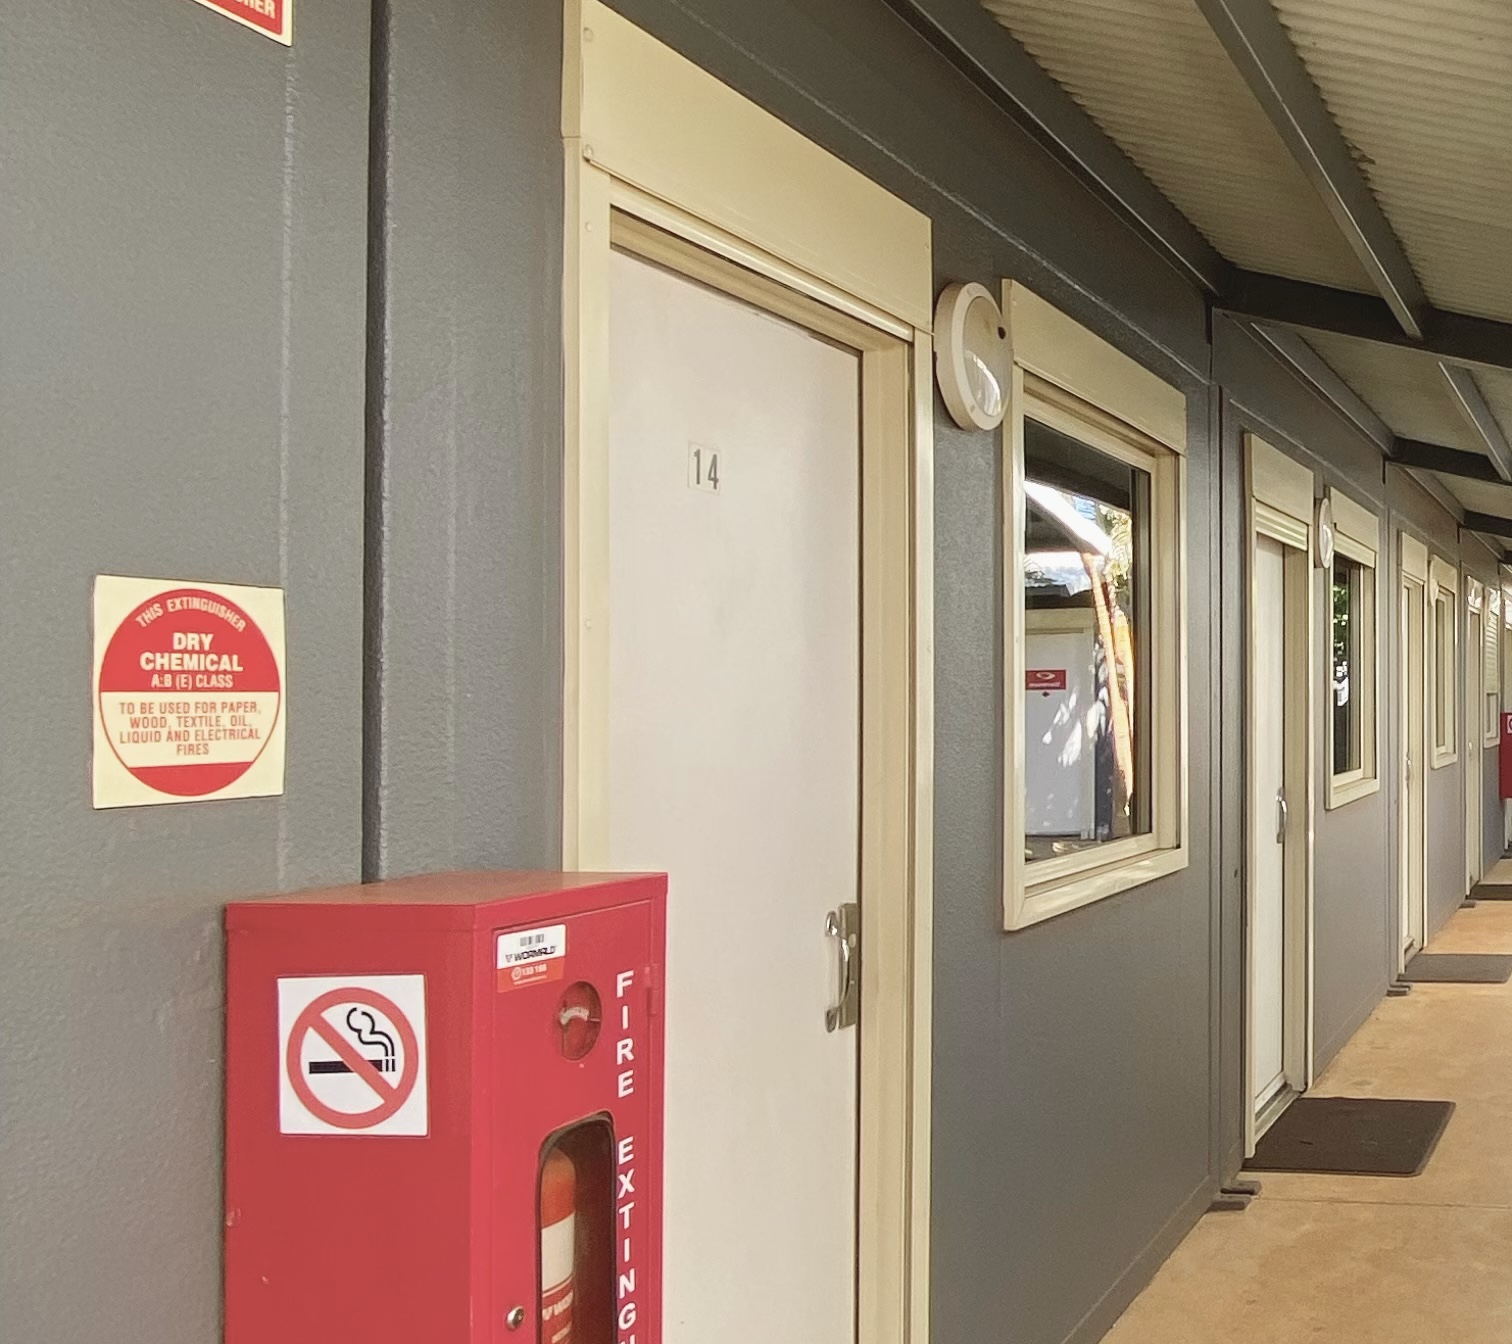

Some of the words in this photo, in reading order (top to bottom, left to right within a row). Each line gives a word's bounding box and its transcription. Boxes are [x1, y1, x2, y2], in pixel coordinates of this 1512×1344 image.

[694, 448, 719, 490] 14
[135, 603, 164, 628] THIS
[166, 596, 247, 633] EXTINGUISHER
[172, 632, 214, 651] DRY
[140, 652, 244, 672] CHEMICAL
[175, 674, 193, 691] (E)
[195, 674, 234, 688] CLASS
[119, 702, 135, 715] TO
[140, 702, 155, 715] BE
[159, 702, 191, 715] USED
[194, 701, 217, 714] FOR
[221, 701, 261, 714] PAPER,
[129, 716, 172, 729] WOOD,
[176, 716, 226, 728] TEXTILE,
[119, 730, 162, 744] LIQUID
[166, 729, 190, 742] AND
[194, 727, 261, 742] ELECTRICAL
[176, 743, 210, 756] FIRES
[616, 969, 635, 1099] FIRE
